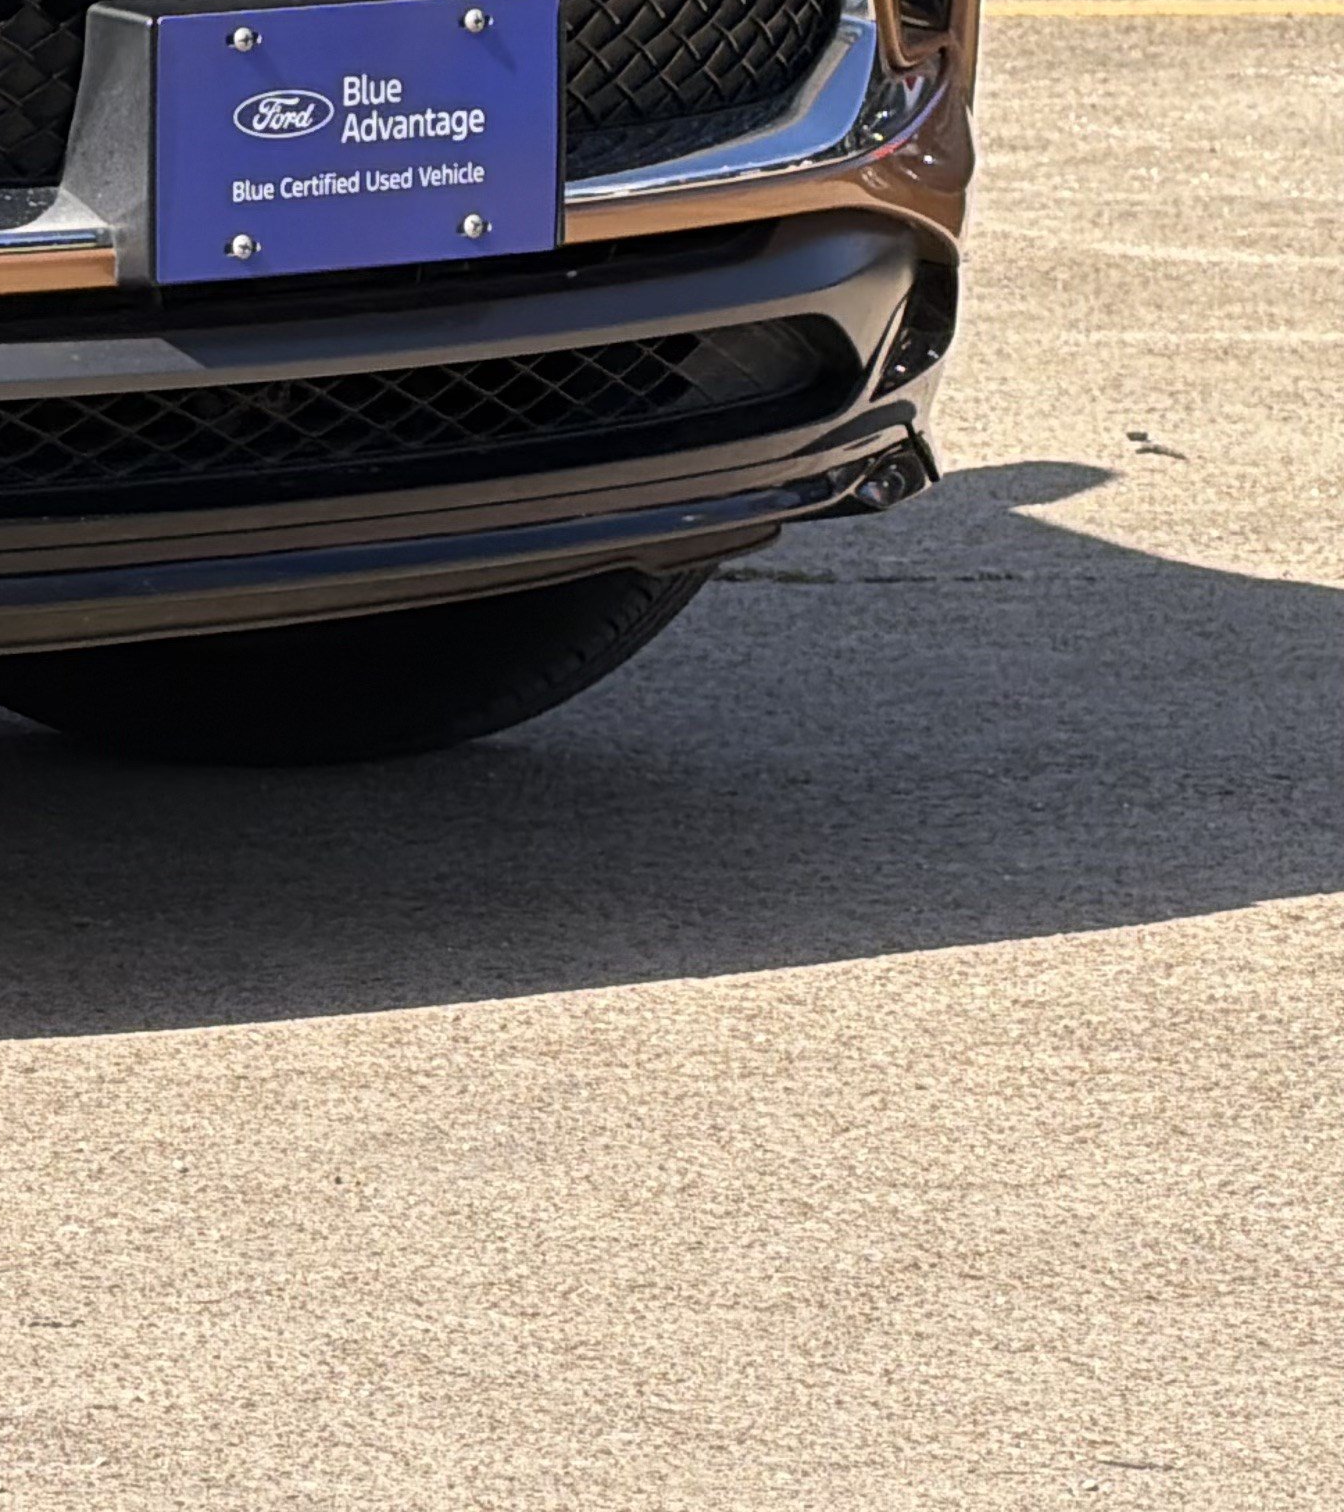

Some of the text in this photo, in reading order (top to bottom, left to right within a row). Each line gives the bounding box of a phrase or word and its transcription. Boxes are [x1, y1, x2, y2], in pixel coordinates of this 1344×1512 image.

[342, 73, 402, 107] Blue
[252, 96, 315, 131] Ford
[340, 108, 486, 144] Advantage
[232, 161, 485, 203] Blue Certified Used Vehicle
